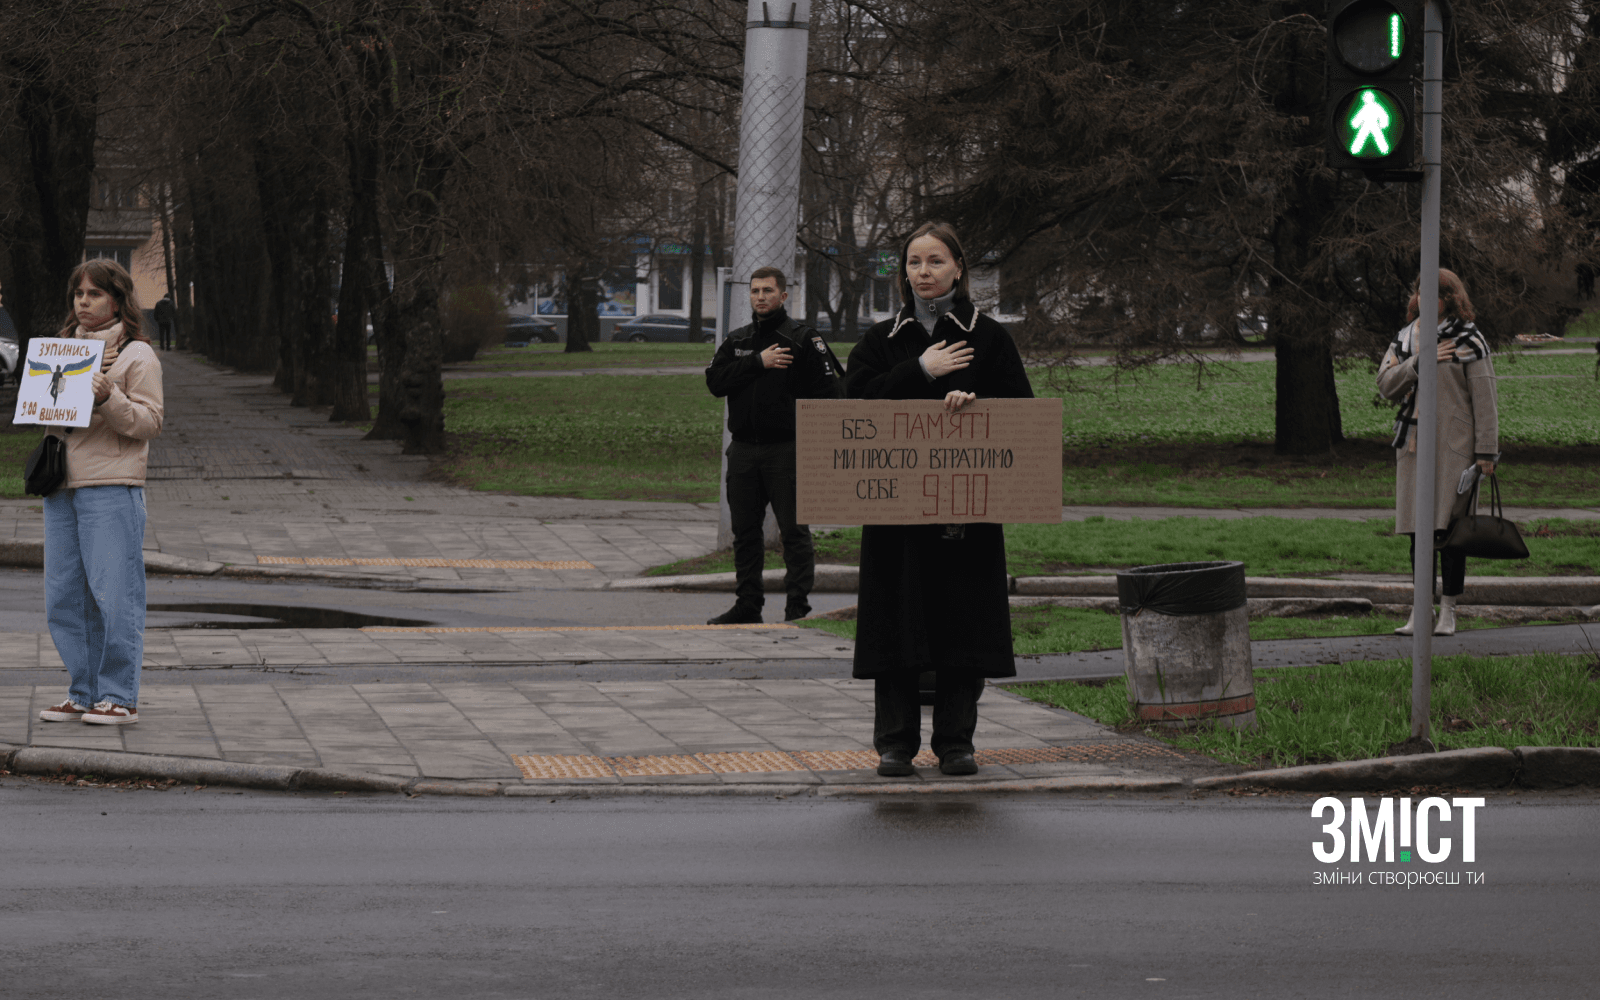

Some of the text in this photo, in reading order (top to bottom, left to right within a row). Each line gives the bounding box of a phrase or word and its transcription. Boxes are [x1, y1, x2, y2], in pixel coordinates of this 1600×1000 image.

[38, 342, 91, 357] ЗУПИНИСЬ
[20, 400, 78, 422] 9:00 ВШАНУЙ
[841, 418, 877, 440] БЕЗ
[833, 448, 1014, 470] МИ ПРОСТО ВТРАТИМО
[856, 473, 989, 517] СЕБЕ 9:00
